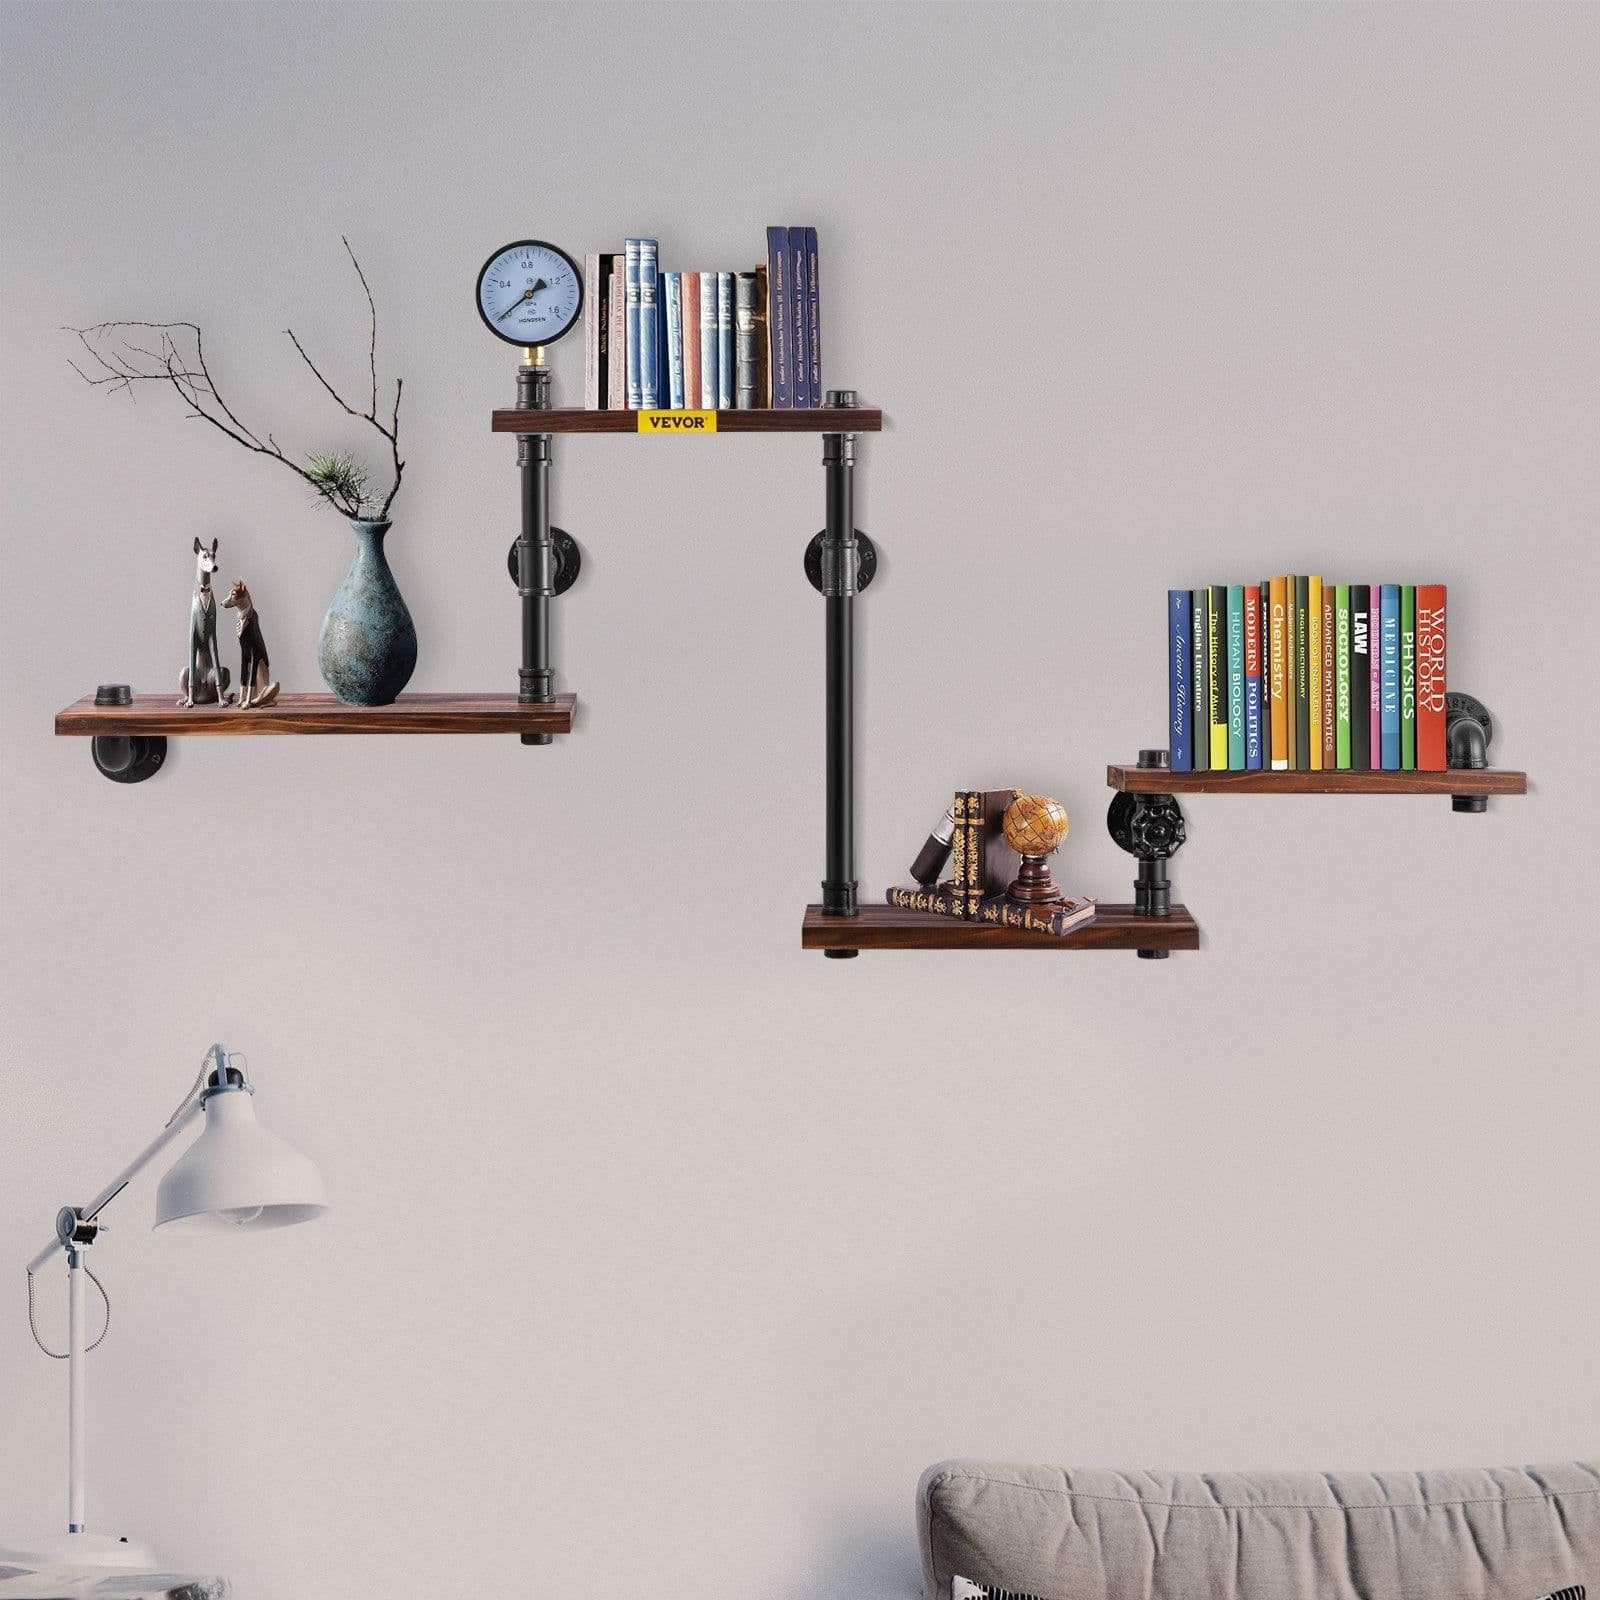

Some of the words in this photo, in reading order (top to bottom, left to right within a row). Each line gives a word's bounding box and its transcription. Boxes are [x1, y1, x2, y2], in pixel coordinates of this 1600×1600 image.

[499, 280, 511, 288] 0.4
[521, 261, 533, 269] 0.8
[548, 306, 560, 314] 1.6
[649, 416, 705, 429] VEVOR
[1175, 624, 1186, 679] Ancient
[1193, 608, 1202, 650] English
[1232, 612, 1241, 668] HUMAN
[1247, 599, 1257, 671] MODERN
[1271, 603, 1285, 700] Chemistry
[1311, 616, 1319, 646] BOOK
[1312, 648, 1319, 659] OF
[1325, 604, 1333, 667] ADVANCED
[1354, 612, 1368, 655] LAW
[1195, 654, 1203, 712] Literature
[1211, 681, 1219, 692] of
[1338, 608, 1349, 723] SOCIOLOGY
[1384, 617, 1396, 713] MEDICINE
[1403, 631, 1414, 720] PHYSICS
[1418, 608, 1431, 712] HISTORY
[1430, 606, 1445, 712] WORLD
[1174, 682, 1186, 736] History
[1212, 695, 1220, 725] Music
[1232, 673, 1242, 738] BIOLOGY
[1248, 682, 1258, 758] POLITICS
[1325, 670, 1333, 752] MATHEMATICS
[1371, 681, 1380, 712] ART
